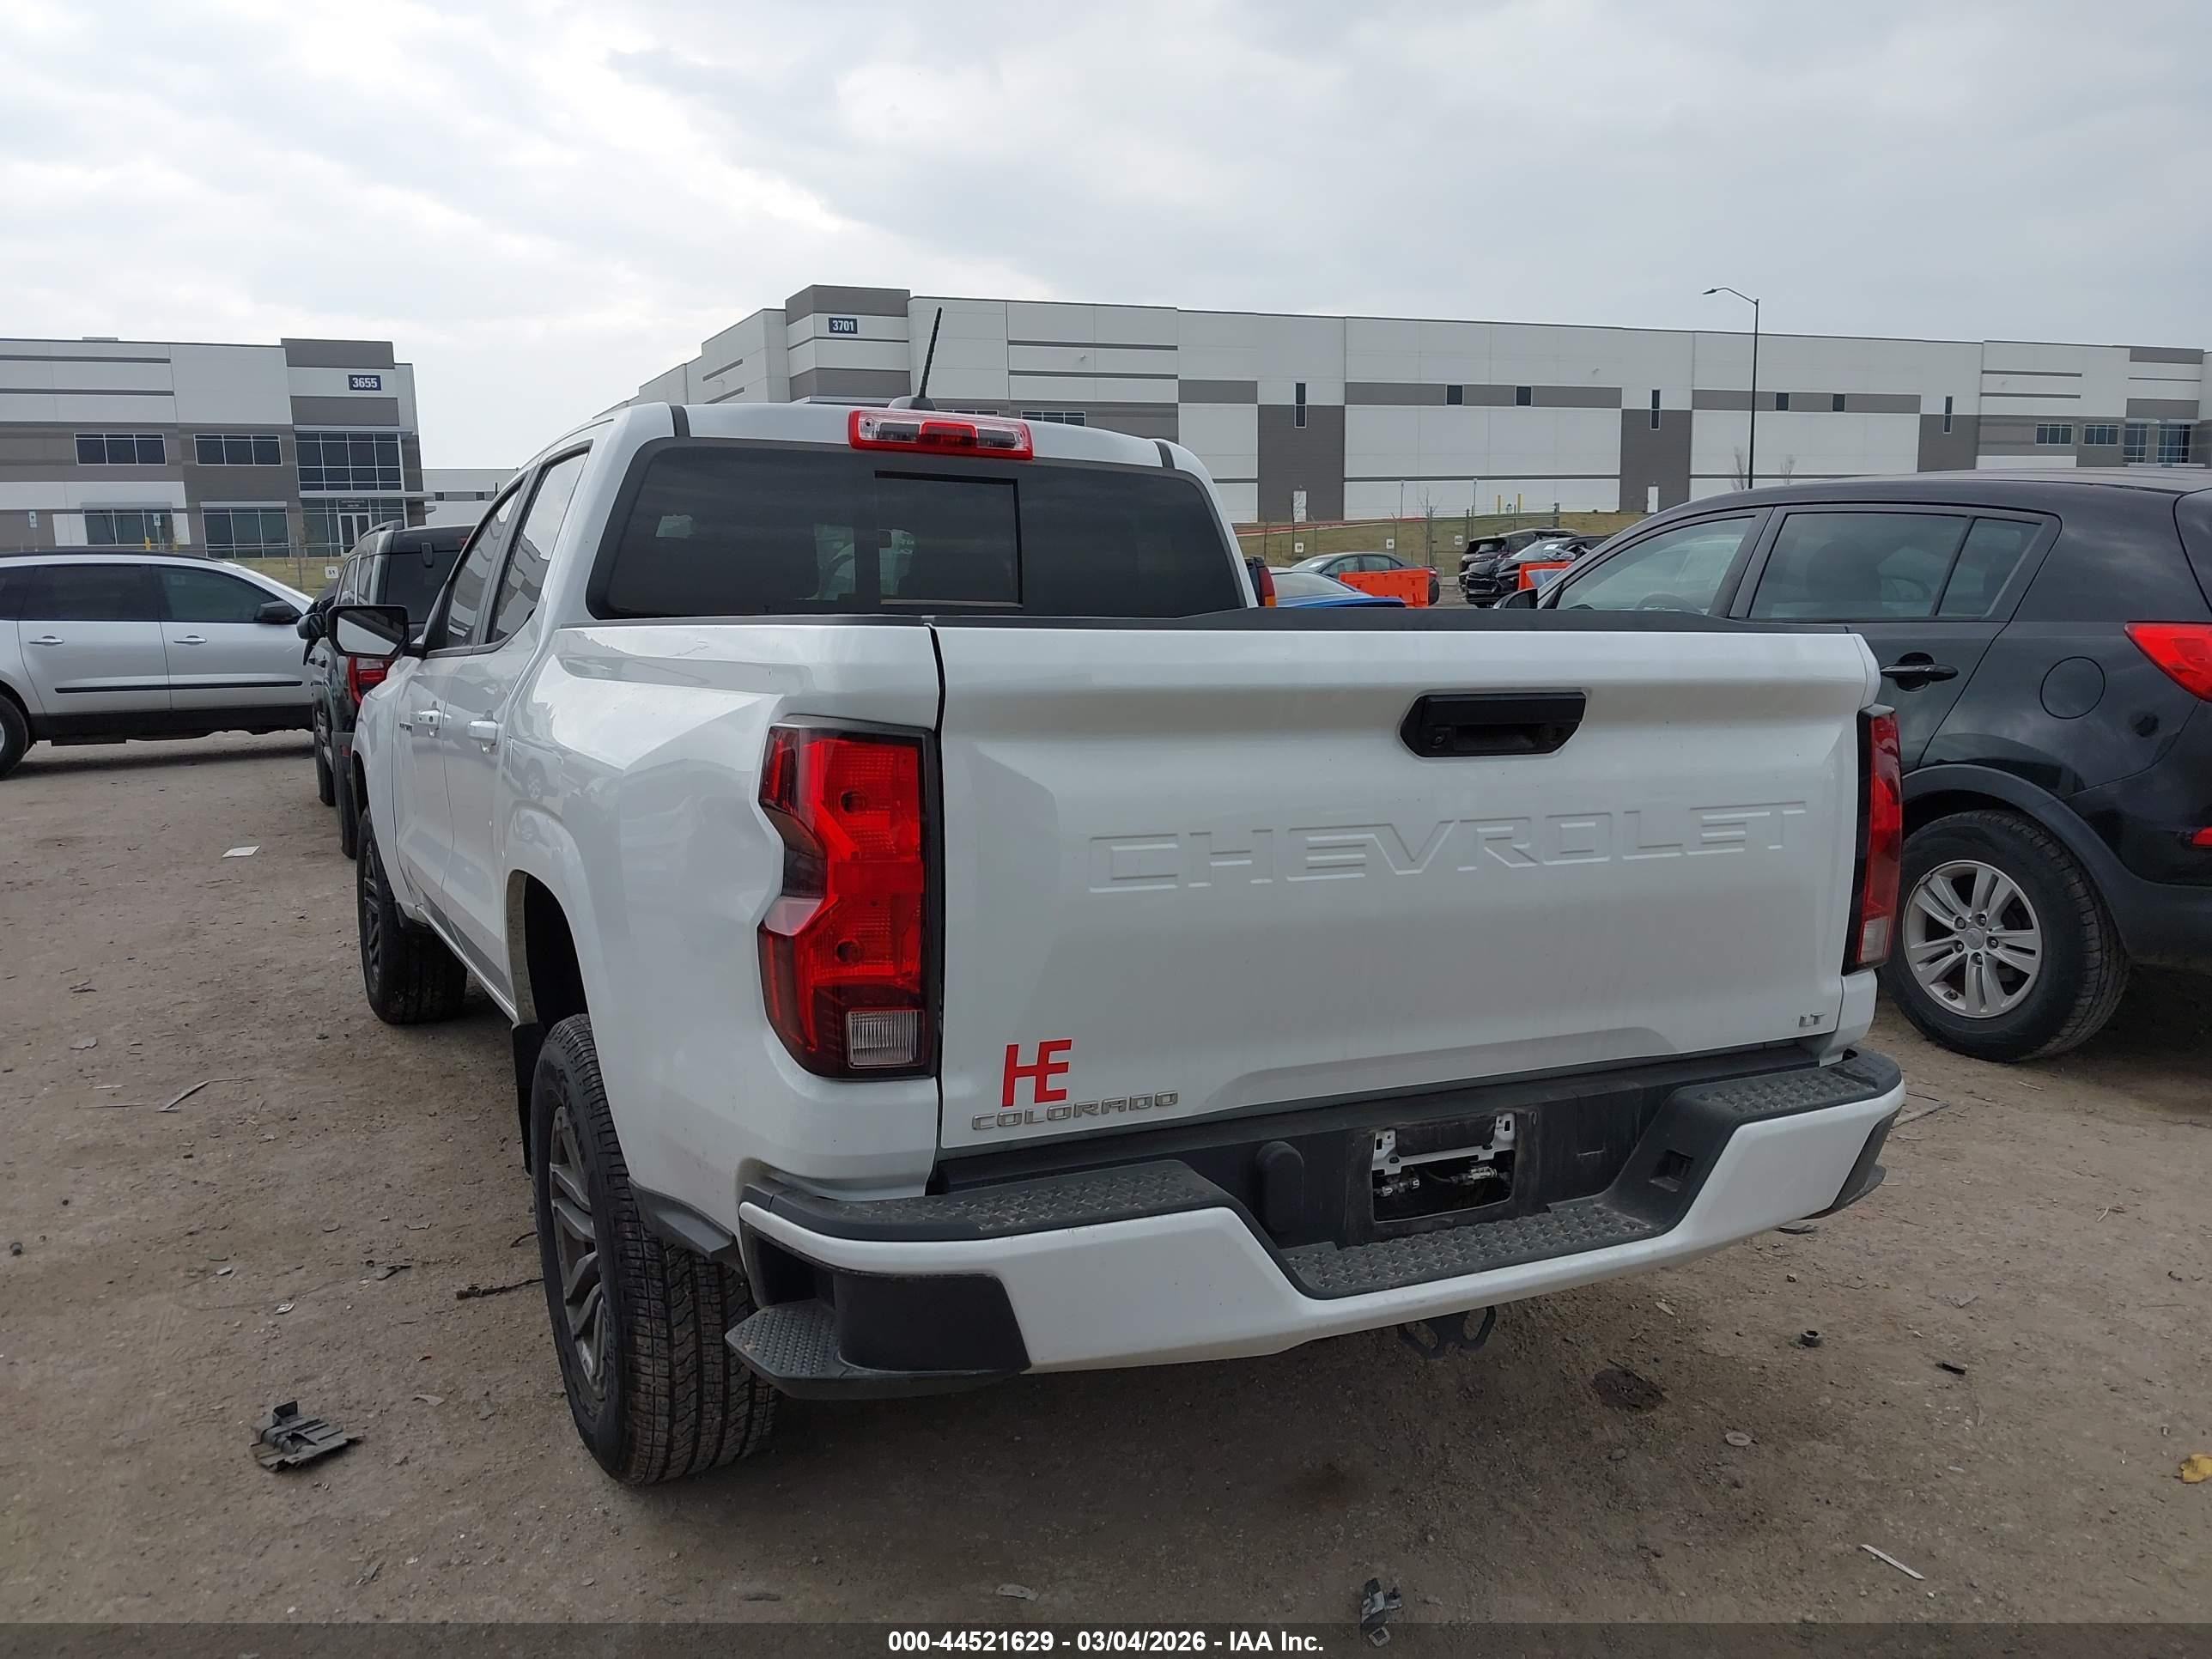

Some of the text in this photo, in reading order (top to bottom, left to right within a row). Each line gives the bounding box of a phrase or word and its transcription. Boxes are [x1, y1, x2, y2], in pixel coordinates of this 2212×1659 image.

[833, 320, 854, 331] 3701
[352, 377, 378, 388] 3655
[1089, 799, 1807, 892] CHEVROLET
[1799, 1012, 1826, 1028] LT
[971, 1090, 1178, 1131] COLORADO
